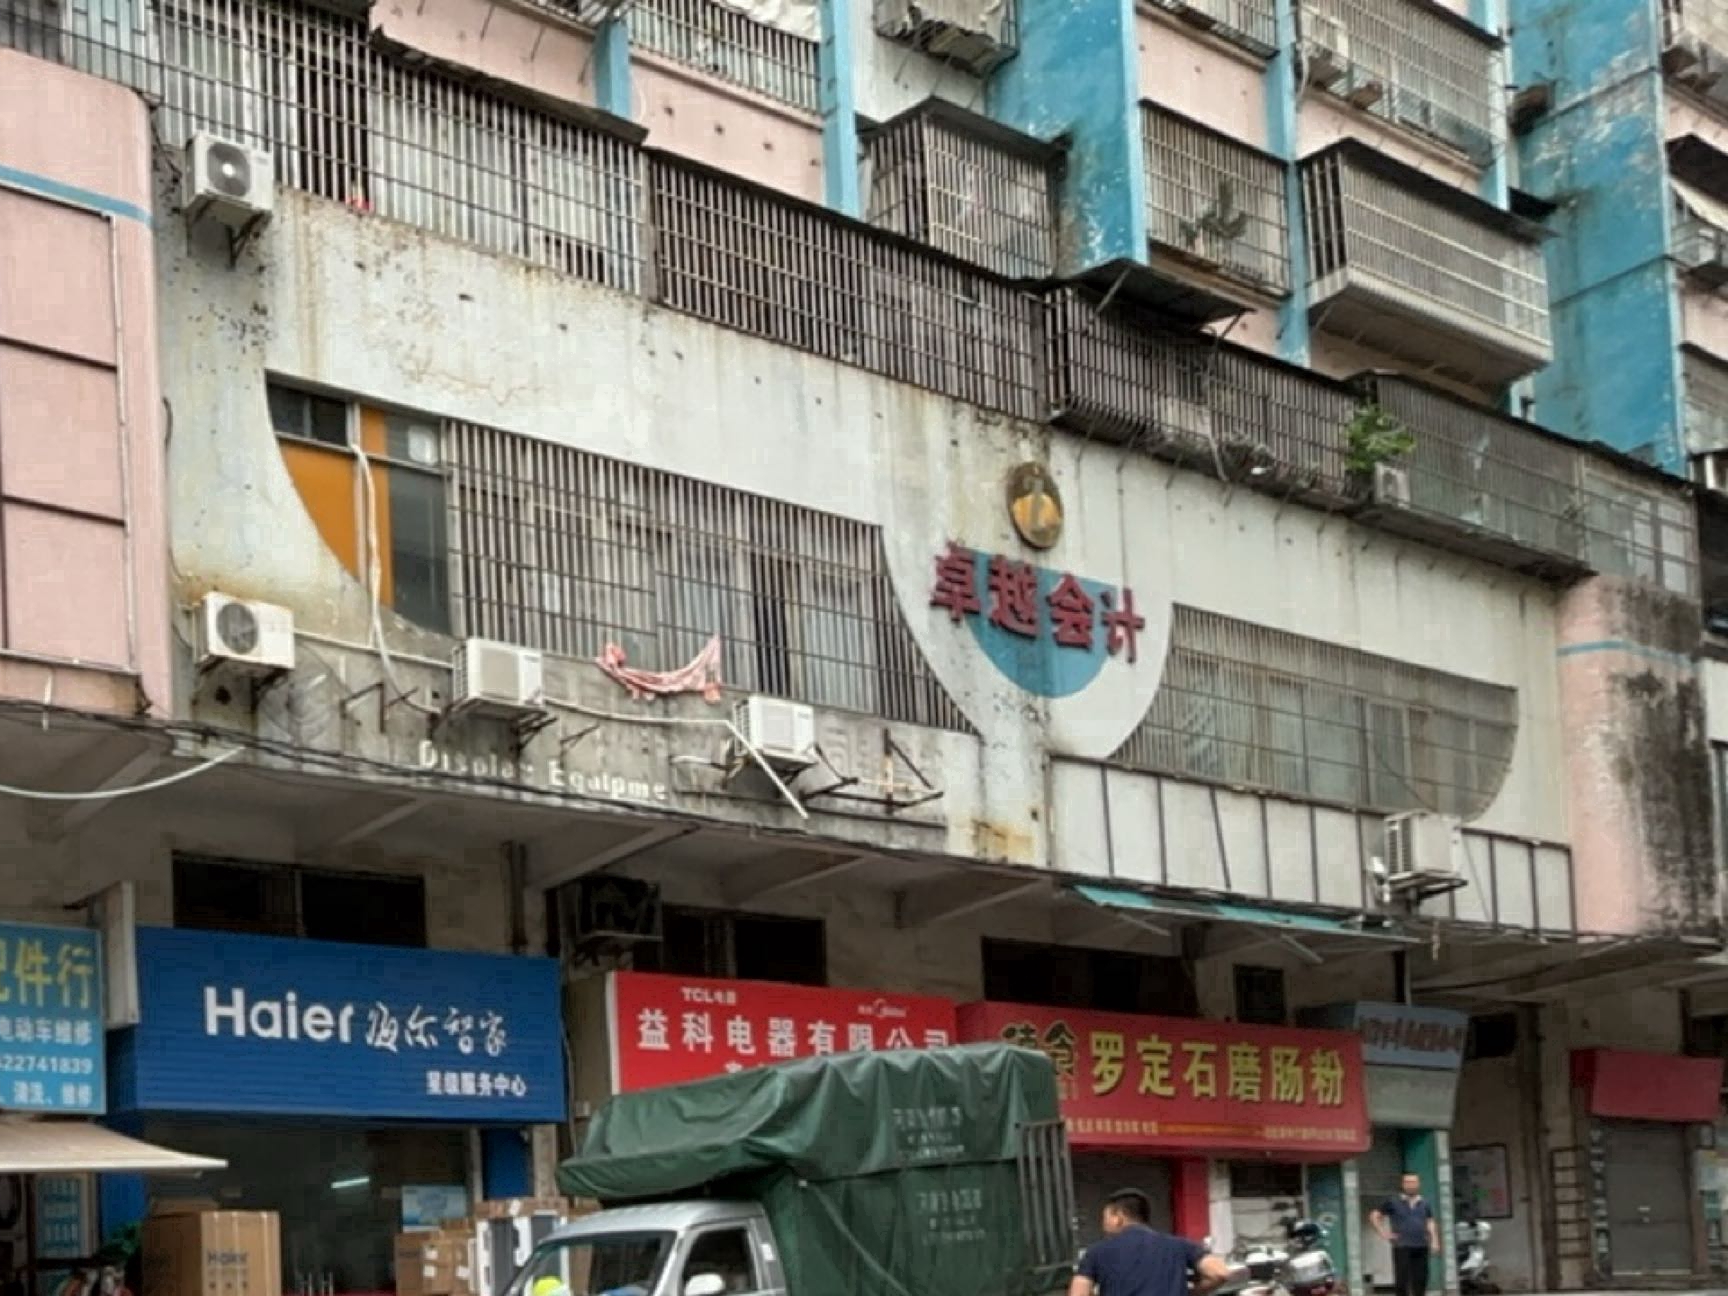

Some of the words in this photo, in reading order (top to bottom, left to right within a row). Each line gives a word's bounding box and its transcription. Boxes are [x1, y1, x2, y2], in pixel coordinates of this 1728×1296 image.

[930, 541, 1145, 664] 卓越会计
[204, 986, 354, 1043] Haier
[637, 1008, 951, 1057] 益科电器有限公司
[1090, 1030, 1346, 1106] 罗定石磨肠粉
